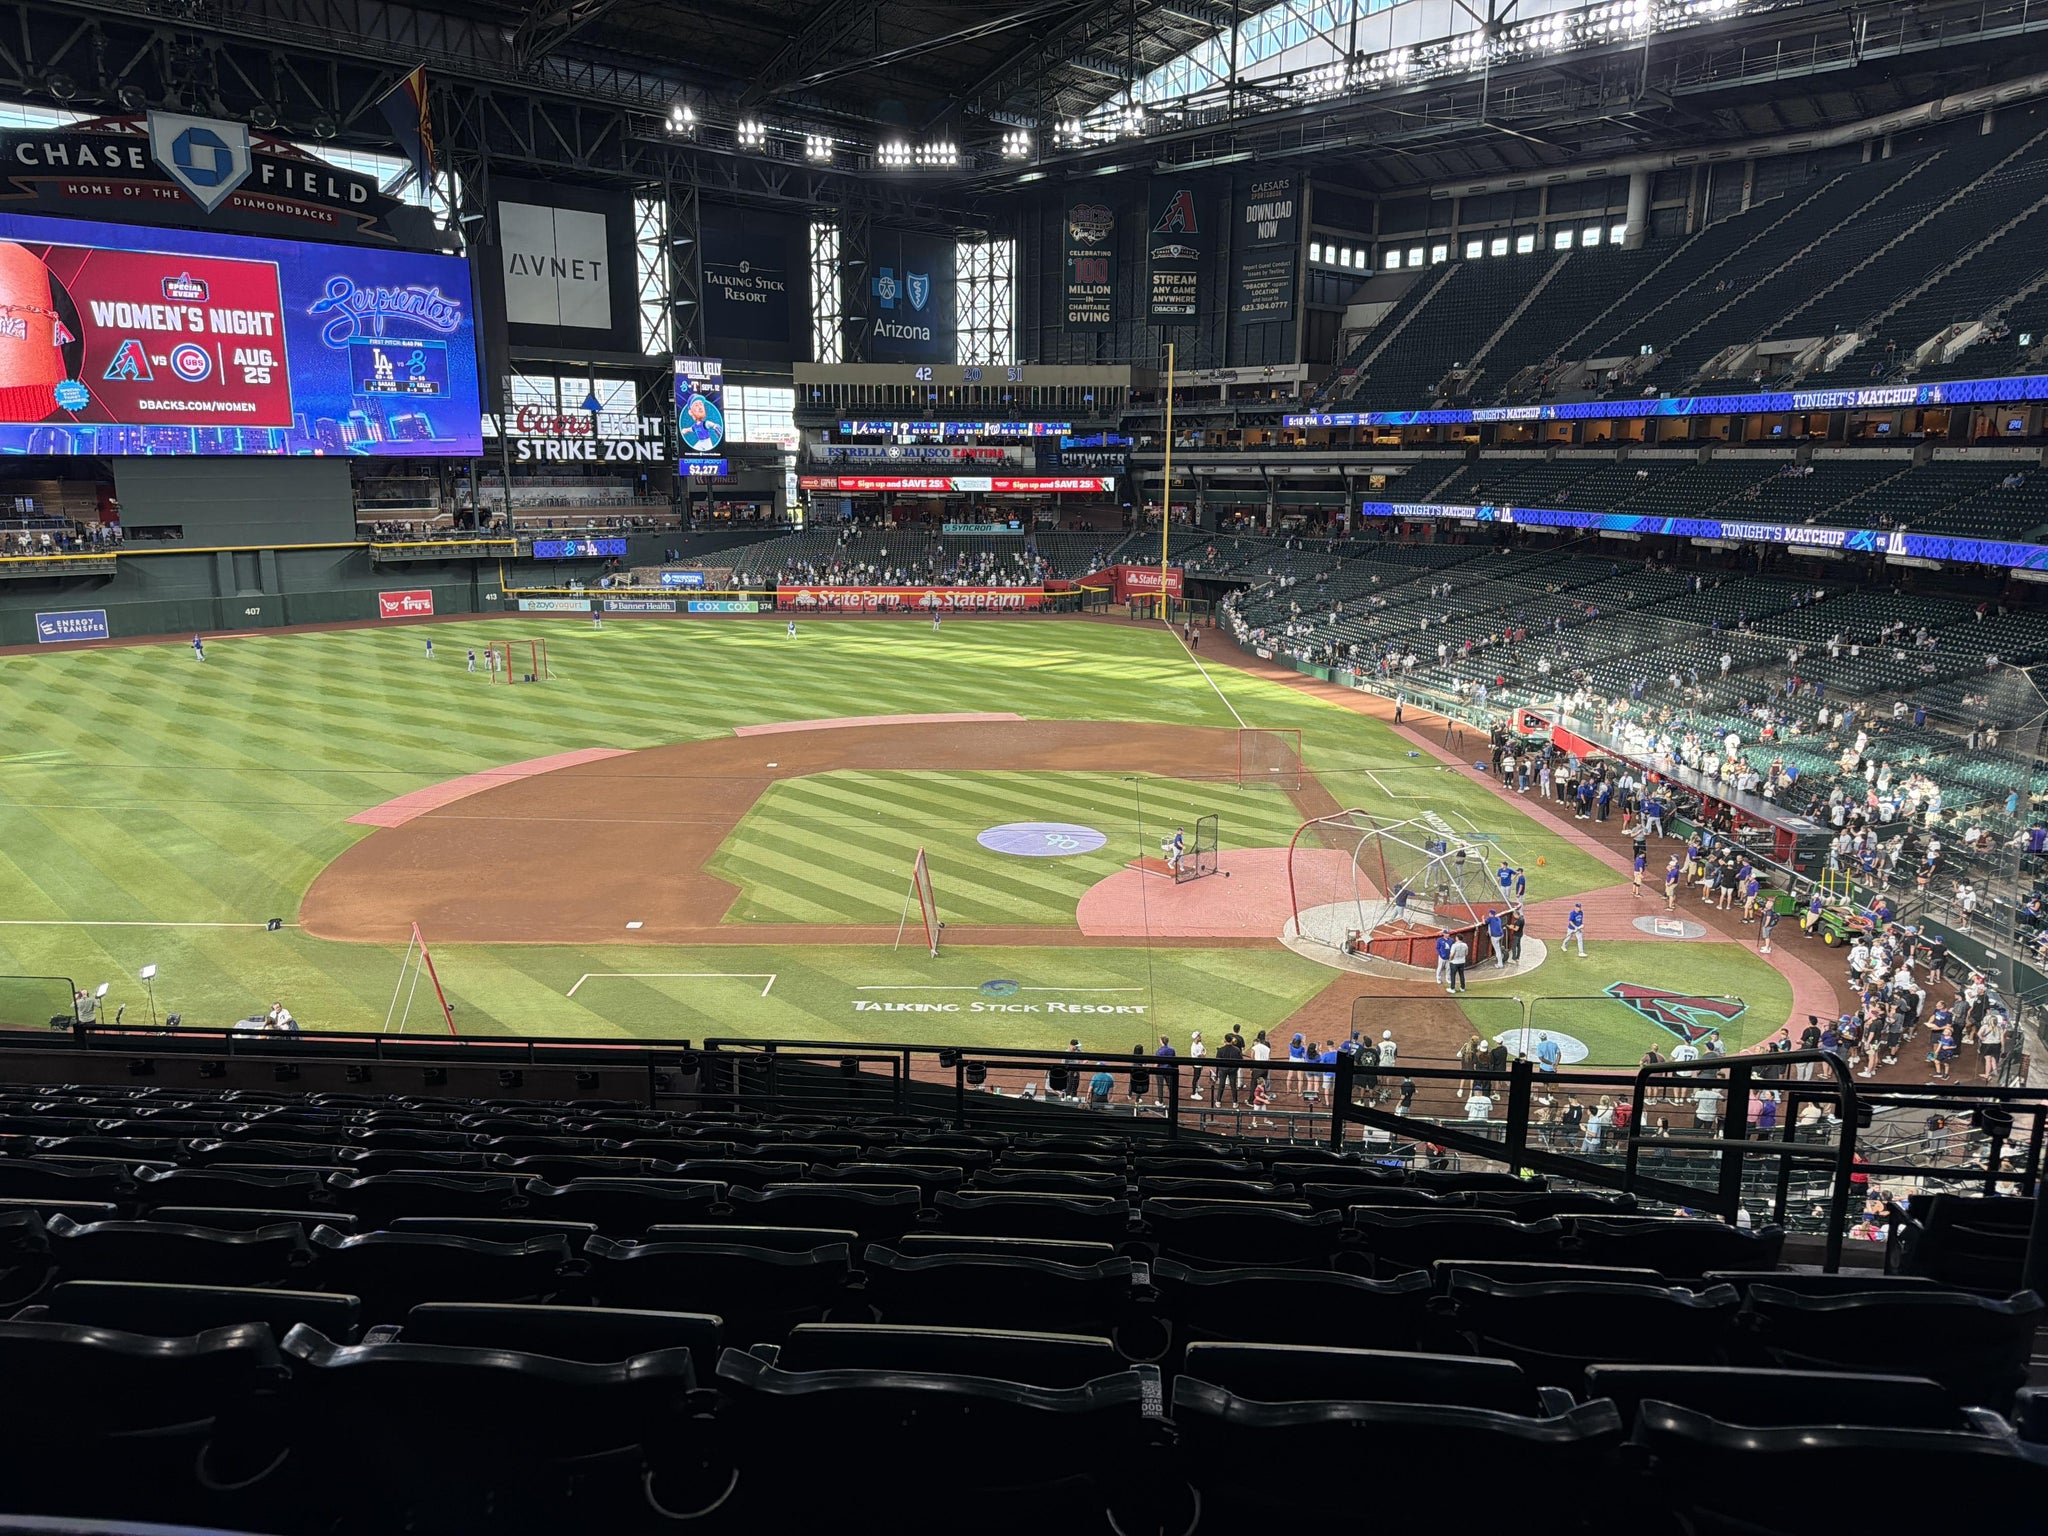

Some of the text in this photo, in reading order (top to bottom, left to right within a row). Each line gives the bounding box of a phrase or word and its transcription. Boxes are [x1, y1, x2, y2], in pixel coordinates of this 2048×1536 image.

[15, 142, 369, 204] CHASE FIELD
[1251, 179, 1290, 193] CAESARS
[68, 184, 334, 222] HOME OF THE DIAMONDBACKS
[1246, 200, 1292, 223] DOWNLOAD
[1258, 221, 1278, 240] NOW
[509, 252, 603, 283] AVNET
[704, 270, 785, 291] TALKING STICK
[1152, 275, 1197, 285] STREAM
[168, 282, 203, 292] SPECIAL
[1069, 285, 1111, 295] MILLION
[1152, 286, 1196, 294] ANY GAME
[1251, 287, 1279, 296] LOCATION
[172, 290, 200, 299] EVENT
[724, 286, 768, 304] RESORT
[1152, 295, 1196, 303] ANYWHERE
[1241, 301, 1289, 312] 623.304.0777
[90, 301, 275, 337] WOMEN'S NIGHT
[306, 276, 461, 350] Serpientes
[1068, 312, 1110, 322] GIVING
[873, 318, 931, 342] Arizona
[234, 349, 279, 367] AUG.
[373, 348, 393, 375] LA
[675, 360, 722, 376] MERRILL KELLY
[244, 367, 272, 385] 25
[915, 367, 1024, 382] 42 20 51
[1793, 387, 1917, 408] TONIGHT'S MATCHUP
[139, 400, 257, 413] DBACKS.COM/WOMEN
[516, 403, 662, 437] Coors LIGHT
[1472, 409, 1506, 421] TONIGHT'S
[1507, 407, 1541, 419] MATCHUP
[1305, 416, 1317, 425] PM
[517, 439, 665, 461] STRIKE ZONE
[827, 447, 1004, 458] ESTRELLA JALISCO CANTINA
[1061, 453, 1125, 465] CUTWATER
[689, 464, 718, 476] $2,277
[858, 480, 875, 488] Sign
[902, 479, 927, 487] SAVE
[1054, 480, 1078, 488] SAVE
[1442, 506, 1475, 518] MATCHUP
[952, 524, 992, 532] SYNCRON
[1720, 523, 1782, 540] TONIGHT'S
[1784, 527, 1845, 545] MATCHUP
[586, 540, 598, 555] LA
[1138, 574, 1176, 586] State Frm
[401, 594, 432, 612] fry's
[485, 593, 498, 601] 413
[818, 590, 900, 606] State Farm
[943, 590, 1025, 607] State Farm
[244, 607, 261, 616] 407
[618, 601, 670, 610] Banner Health
[696, 602, 750, 611] COX COX
[759, 602, 772, 610] 374
[57, 618, 95, 627] ENERGY
[57, 623, 105, 633] TRANSFER
[851, 1000, 1149, 1014] TALKING STICK RESORT
[1683, 1054, 1693, 1062] 17
[1141, 1403, 1163, 1411] OOD
